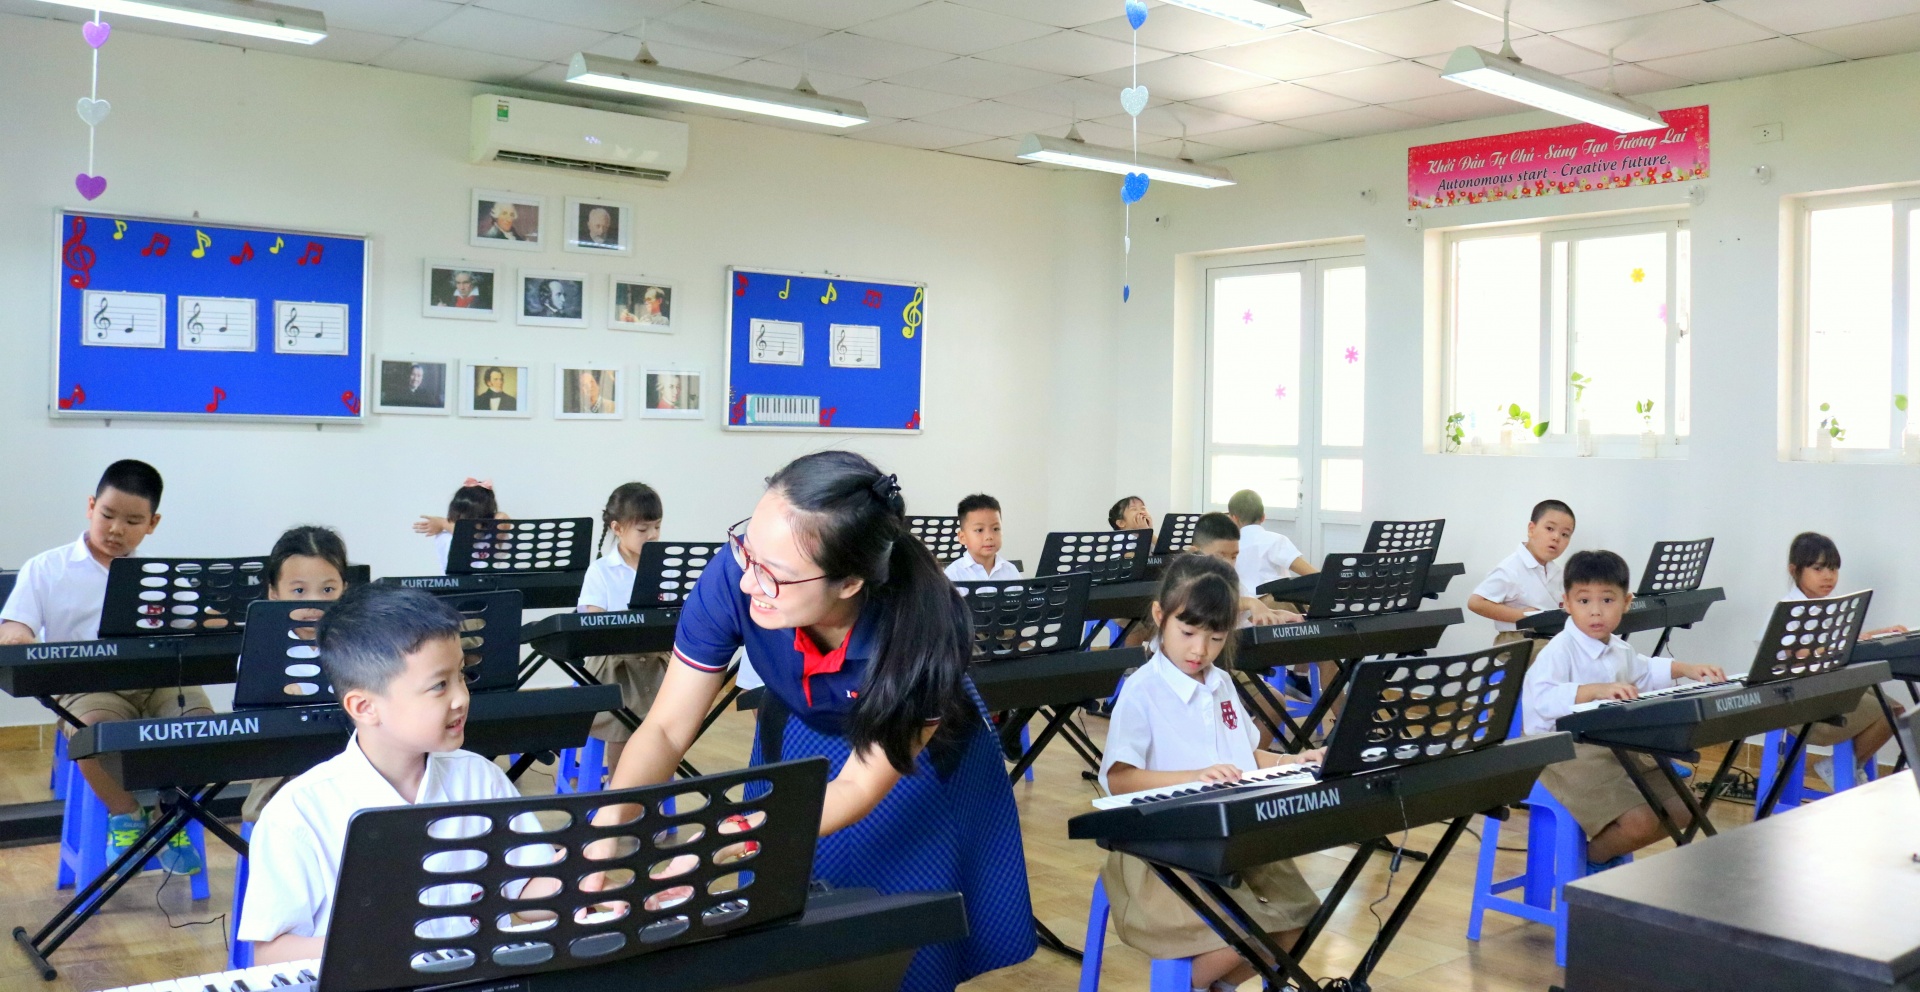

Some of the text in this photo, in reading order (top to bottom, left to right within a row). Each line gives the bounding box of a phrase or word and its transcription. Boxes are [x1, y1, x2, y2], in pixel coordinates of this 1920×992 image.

[1424, 158, 1456, 175] Khởi
[1459, 153, 1486, 171] Đầu
[1490, 152, 1509, 170] Tự
[1510, 147, 1535, 165] Chủ
[1544, 144, 1578, 160] Sáng
[1582, 139, 1608, 157] Tạo
[1614, 135, 1657, 150] Tương
[1660, 127, 1688, 144] Lai
[1437, 173, 1513, 191] Autonomous
[1517, 168, 1548, 182] start
[1561, 159, 1617, 177] Creative
[1621, 154, 1671, 171] future.
[401, 578, 459, 588] KURTZMAN
[580, 613, 645, 627] KURTZMAN
[1272, 625, 1320, 639] KURTZMAN
[26, 643, 118, 660] KURTZMAN
[1715, 691, 1761, 712] KURTZMAN
[138, 717, 260, 742] KURTZMAN
[1255, 787, 1341, 821] KURTZMAN
